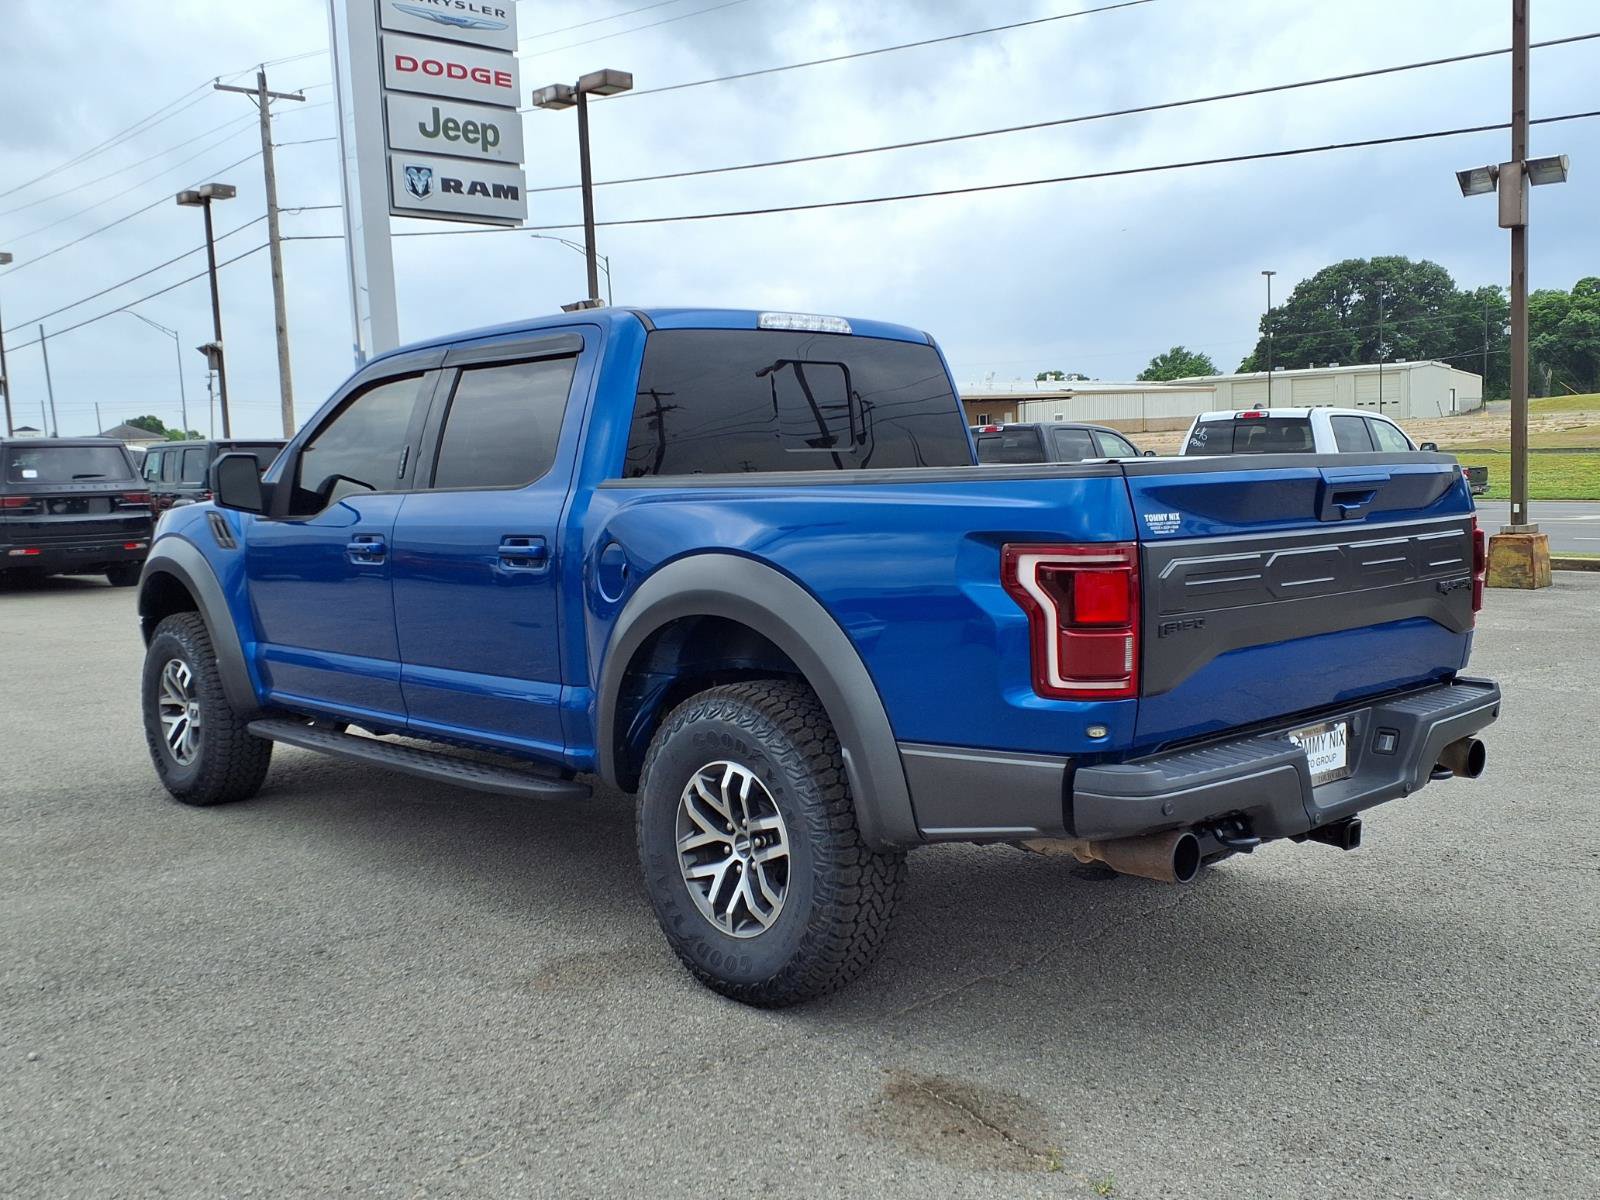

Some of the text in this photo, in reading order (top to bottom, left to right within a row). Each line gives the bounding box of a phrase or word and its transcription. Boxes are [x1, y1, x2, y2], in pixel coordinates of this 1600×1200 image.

[395, 55, 512, 88] DODGE
[418, 107, 500, 152] Jeep
[441, 177, 520, 201] RAM
[1144, 512, 1180, 522] TOMMY NIX
[1329, 729, 1346, 749] NIX
[1315, 753, 1337, 767] GROUP
